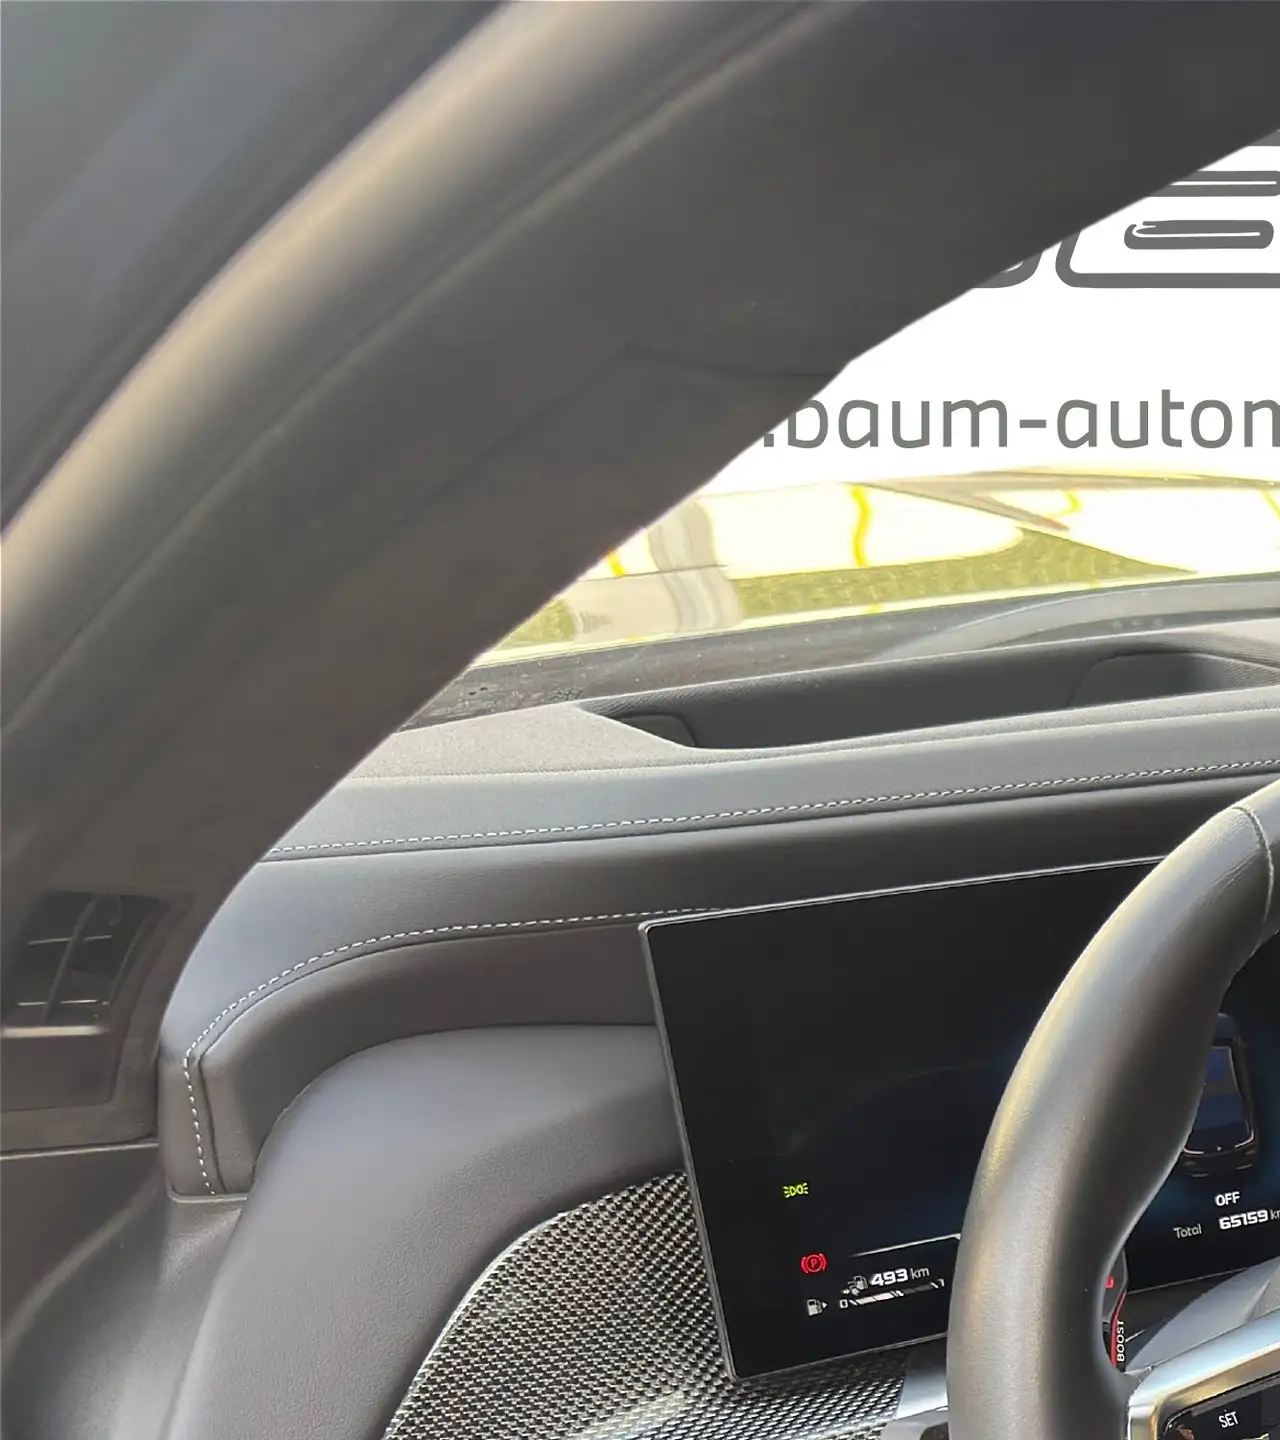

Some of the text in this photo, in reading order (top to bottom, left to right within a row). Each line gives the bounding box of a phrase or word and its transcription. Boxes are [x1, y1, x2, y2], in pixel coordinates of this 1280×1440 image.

[1214, 1191, 1240, 1207] OFF
[1173, 1223, 1203, 1239] Total
[1218, 1209, 1269, 1230] 65159
[870, 1267, 931, 1286] 493 km
[1116, 1319, 1125, 1362] BOOST
[1218, 1411, 1239, 1428] SET
